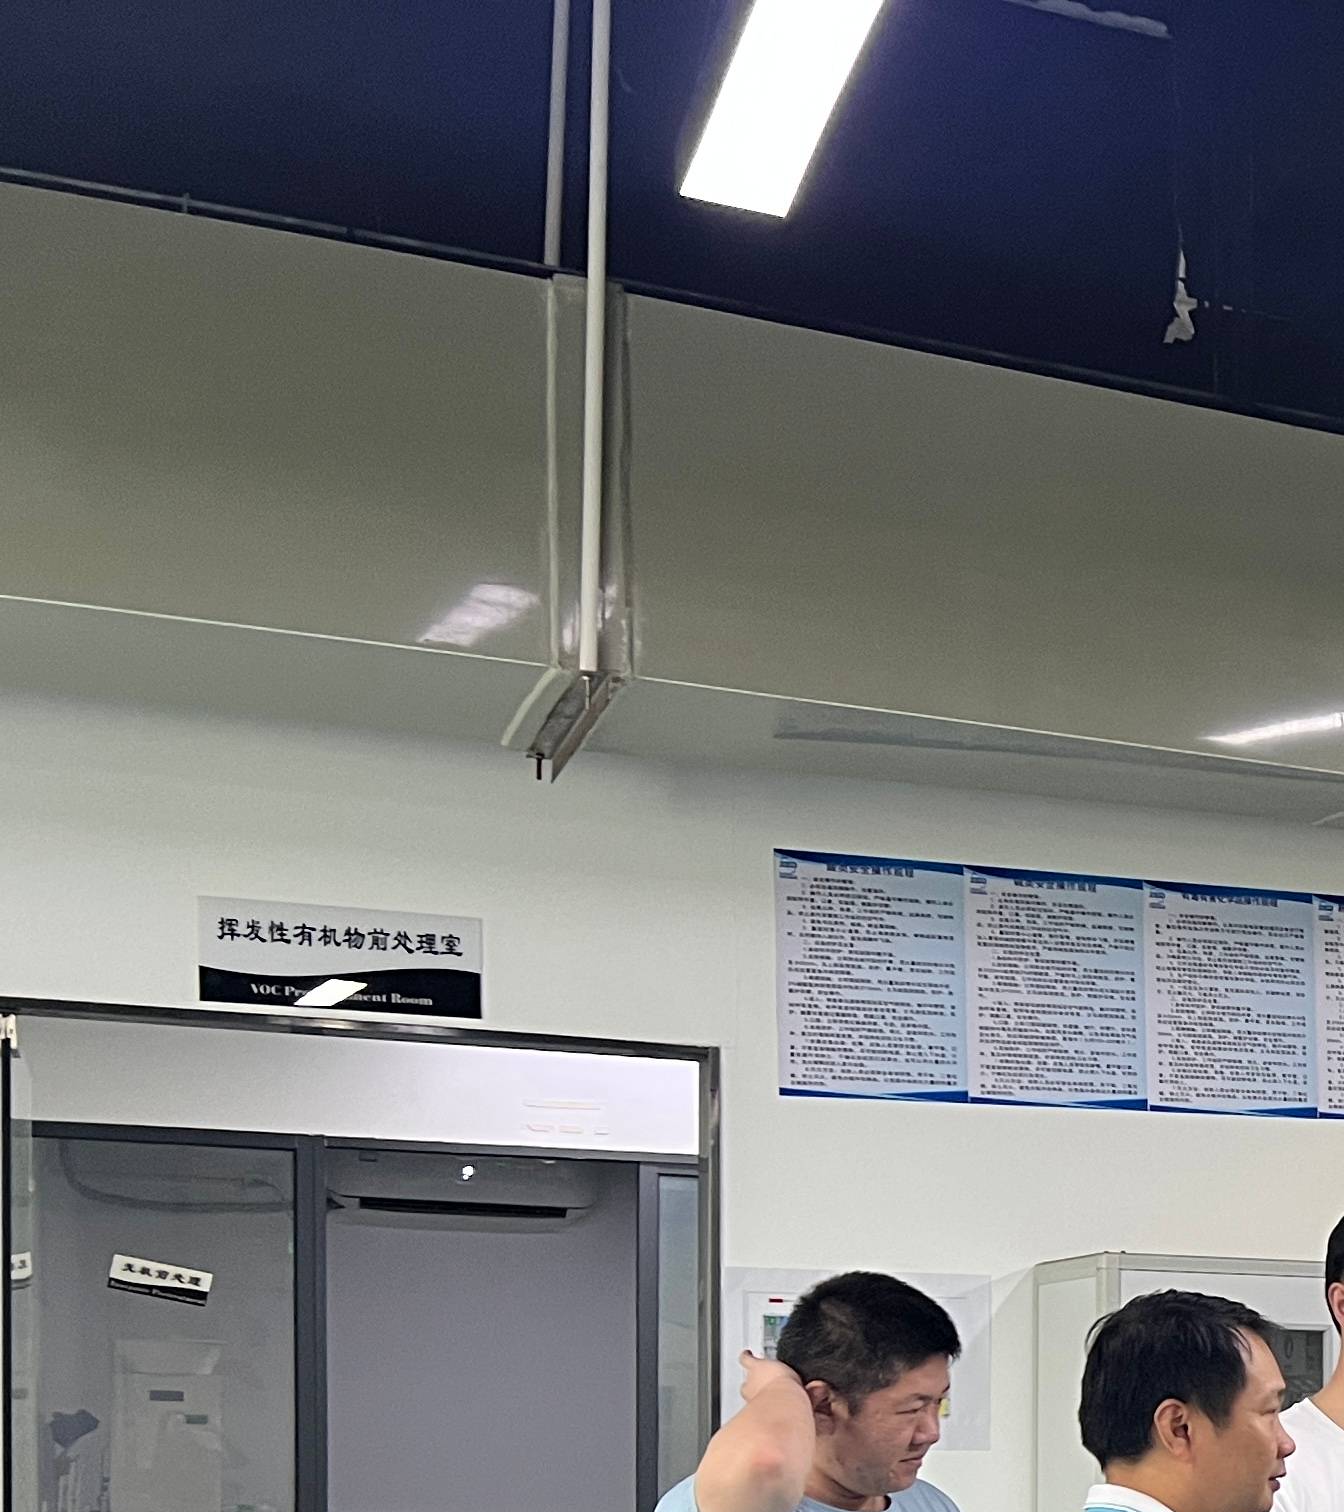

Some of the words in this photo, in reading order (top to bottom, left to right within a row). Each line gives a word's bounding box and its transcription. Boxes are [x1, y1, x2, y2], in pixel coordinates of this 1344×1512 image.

[217, 917, 463, 957] 挥发性有机物前处理室
[250, 983, 282, 996] VOC
[390, 993, 433, 1006] Room
